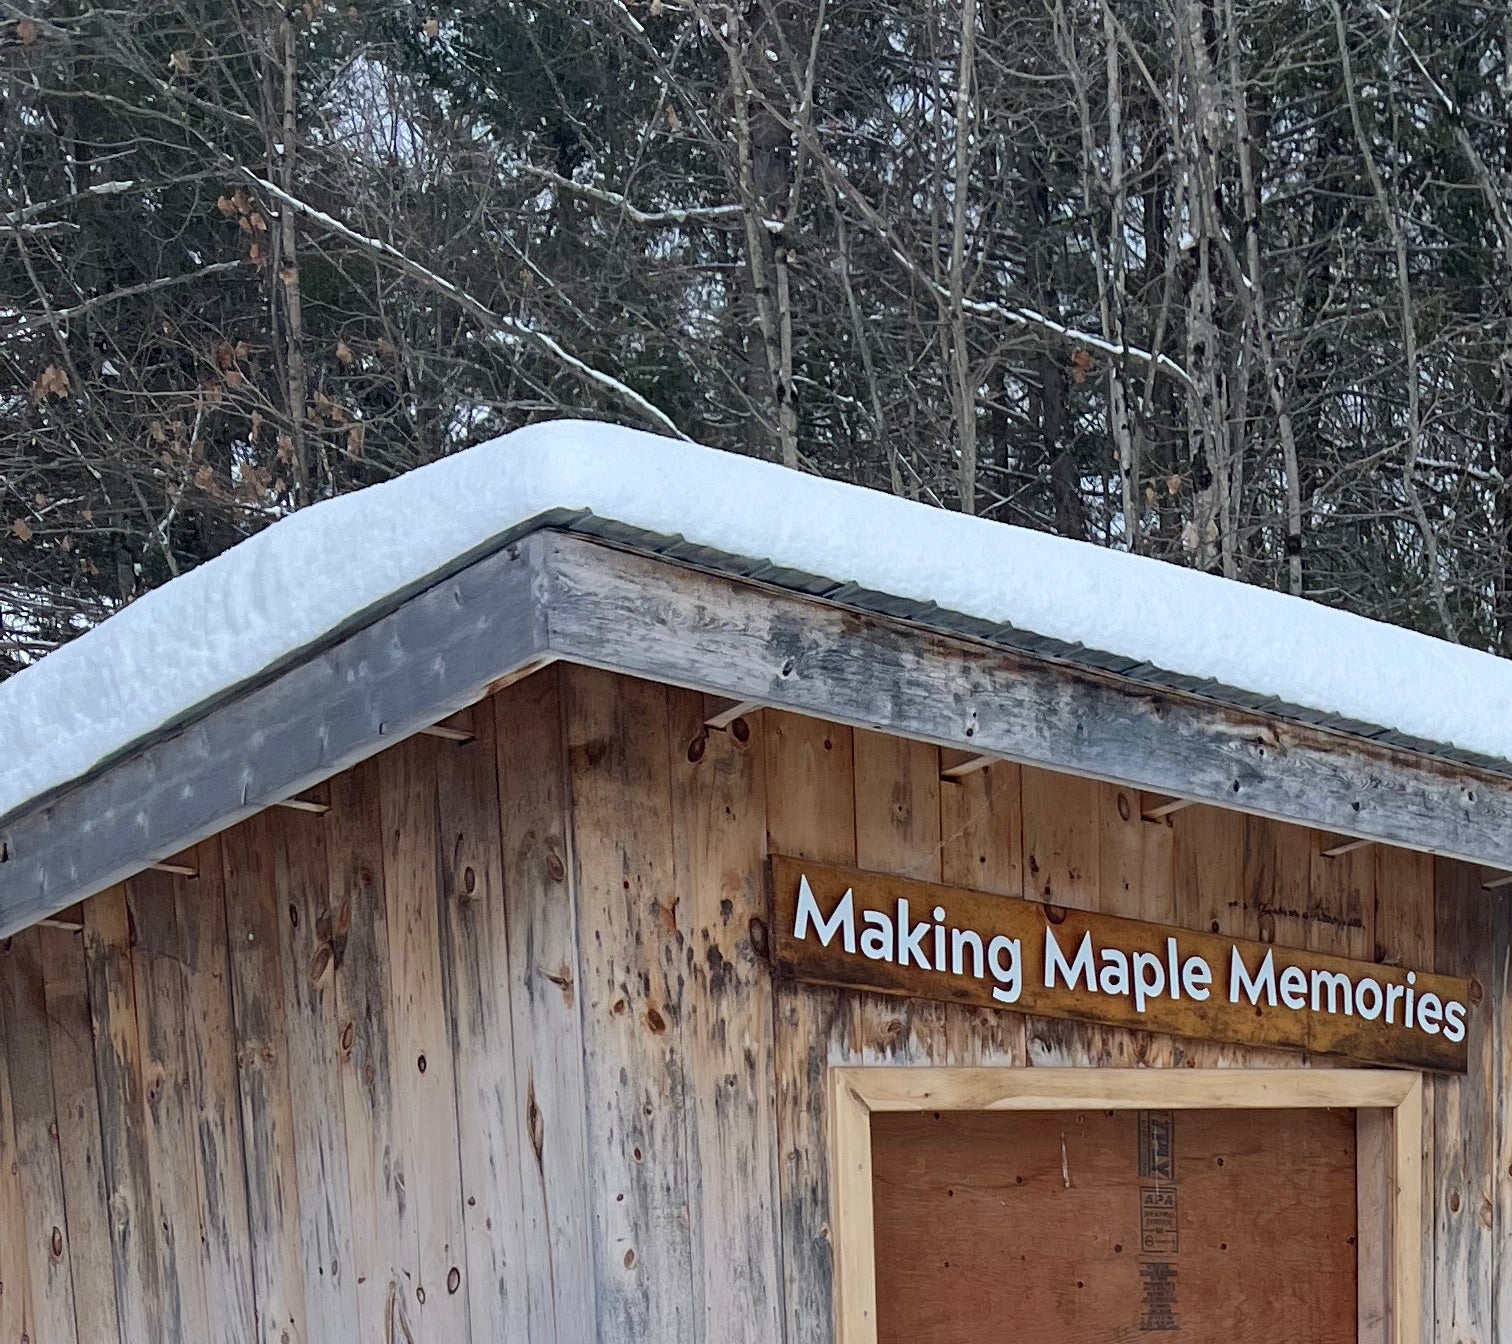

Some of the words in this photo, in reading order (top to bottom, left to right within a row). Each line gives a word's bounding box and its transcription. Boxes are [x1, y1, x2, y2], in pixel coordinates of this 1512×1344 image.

[793, 874, 1022, 1002] Making
[1044, 926, 1212, 1013] Maple
[1229, 944, 1468, 1042] Memories
[1144, 1193, 1173, 1205] APA
